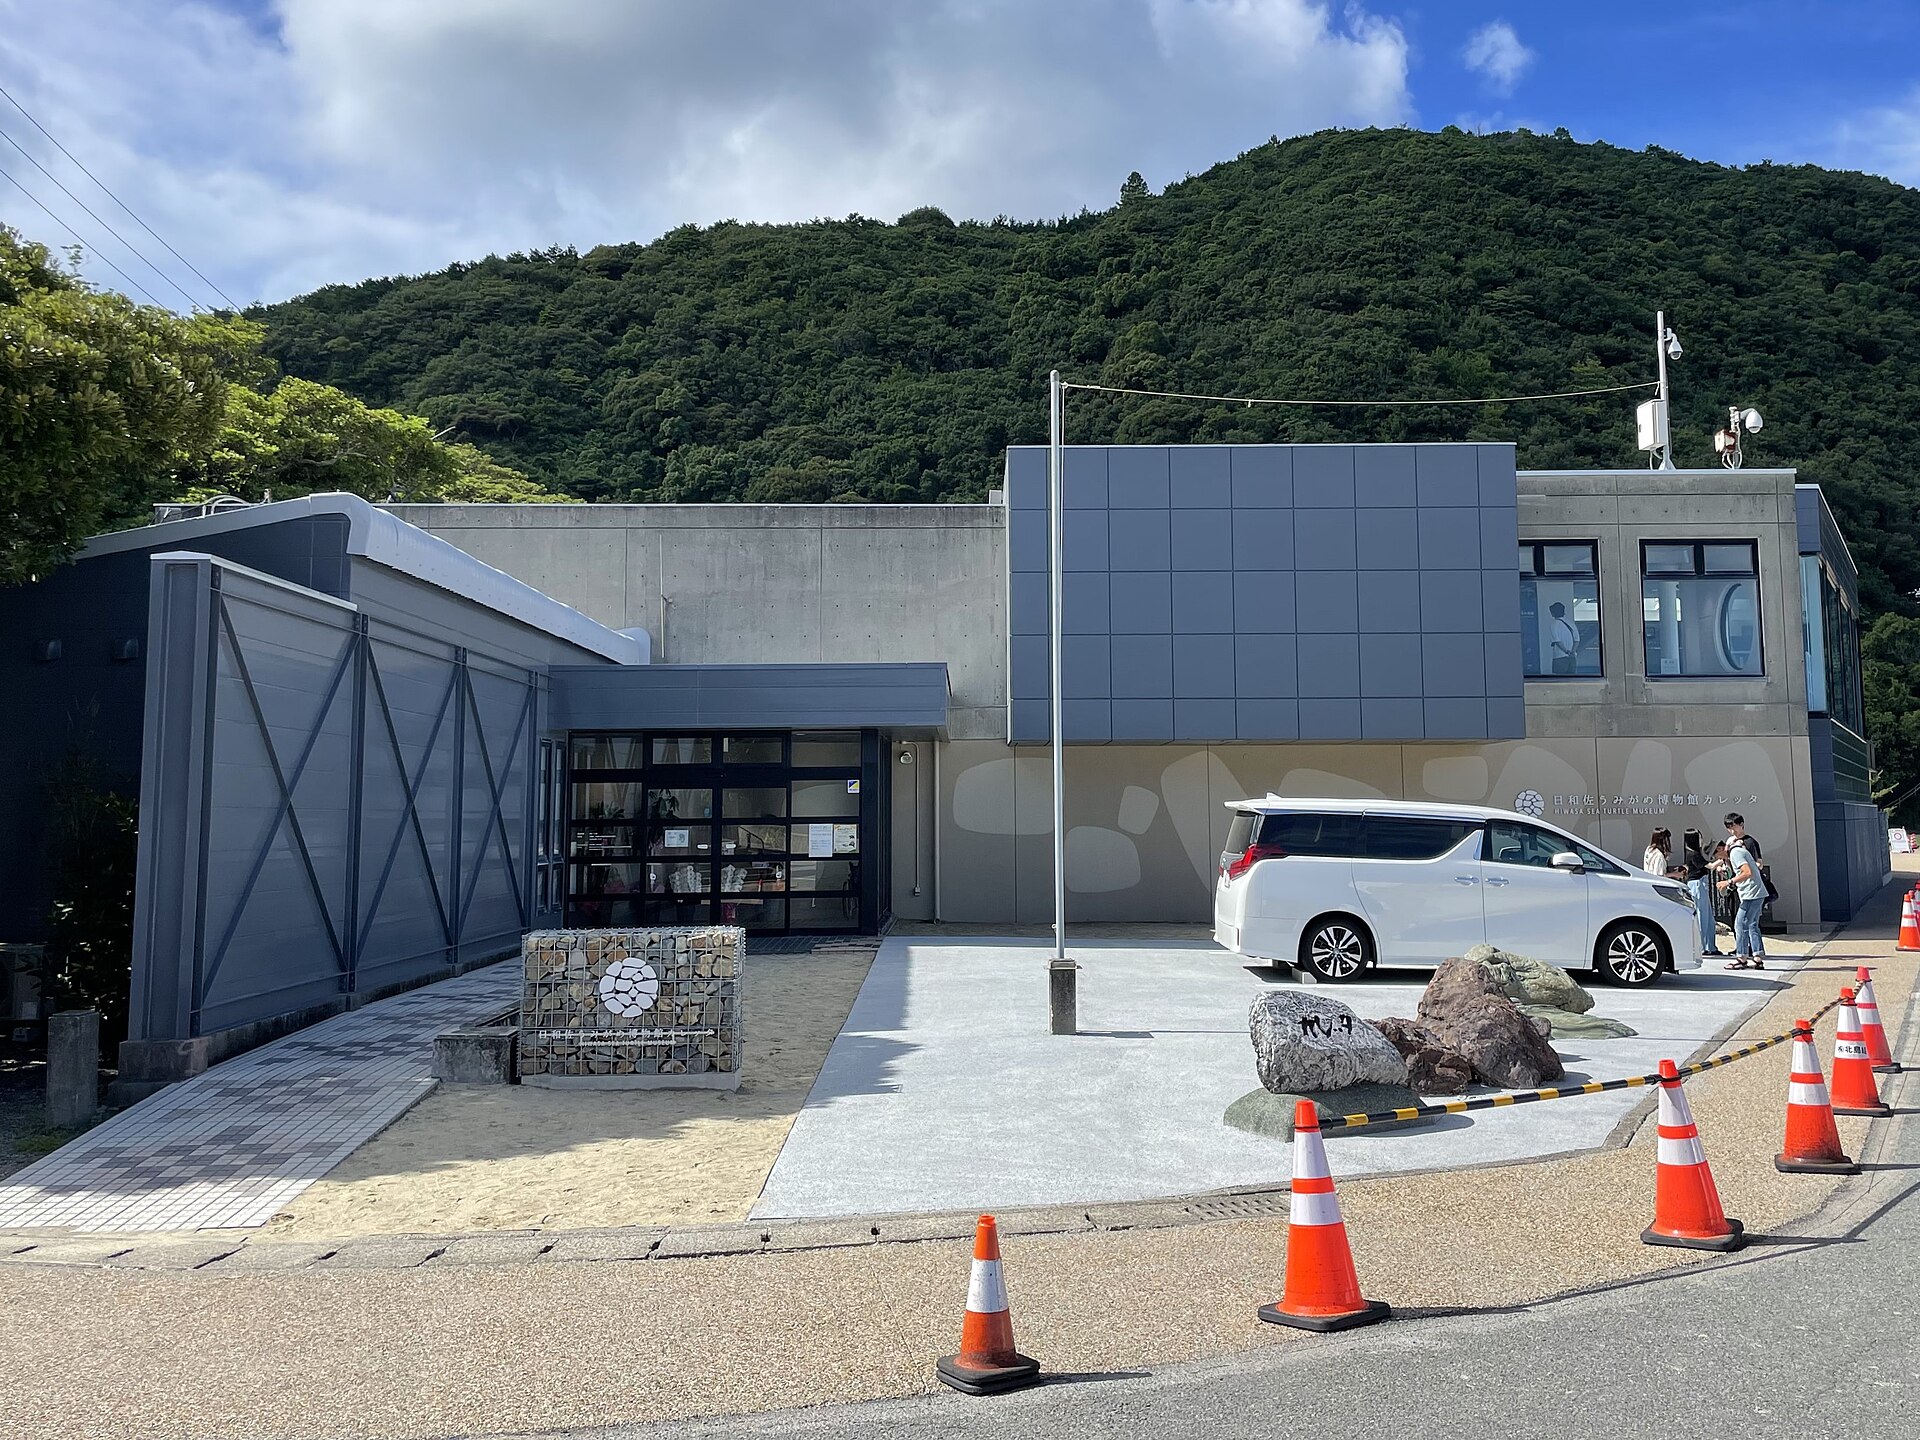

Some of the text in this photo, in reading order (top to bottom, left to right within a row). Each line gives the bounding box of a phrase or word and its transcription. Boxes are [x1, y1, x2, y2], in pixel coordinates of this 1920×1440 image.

[1554, 794, 1758, 806] 日和佐うみがめ博物館カレッタ
